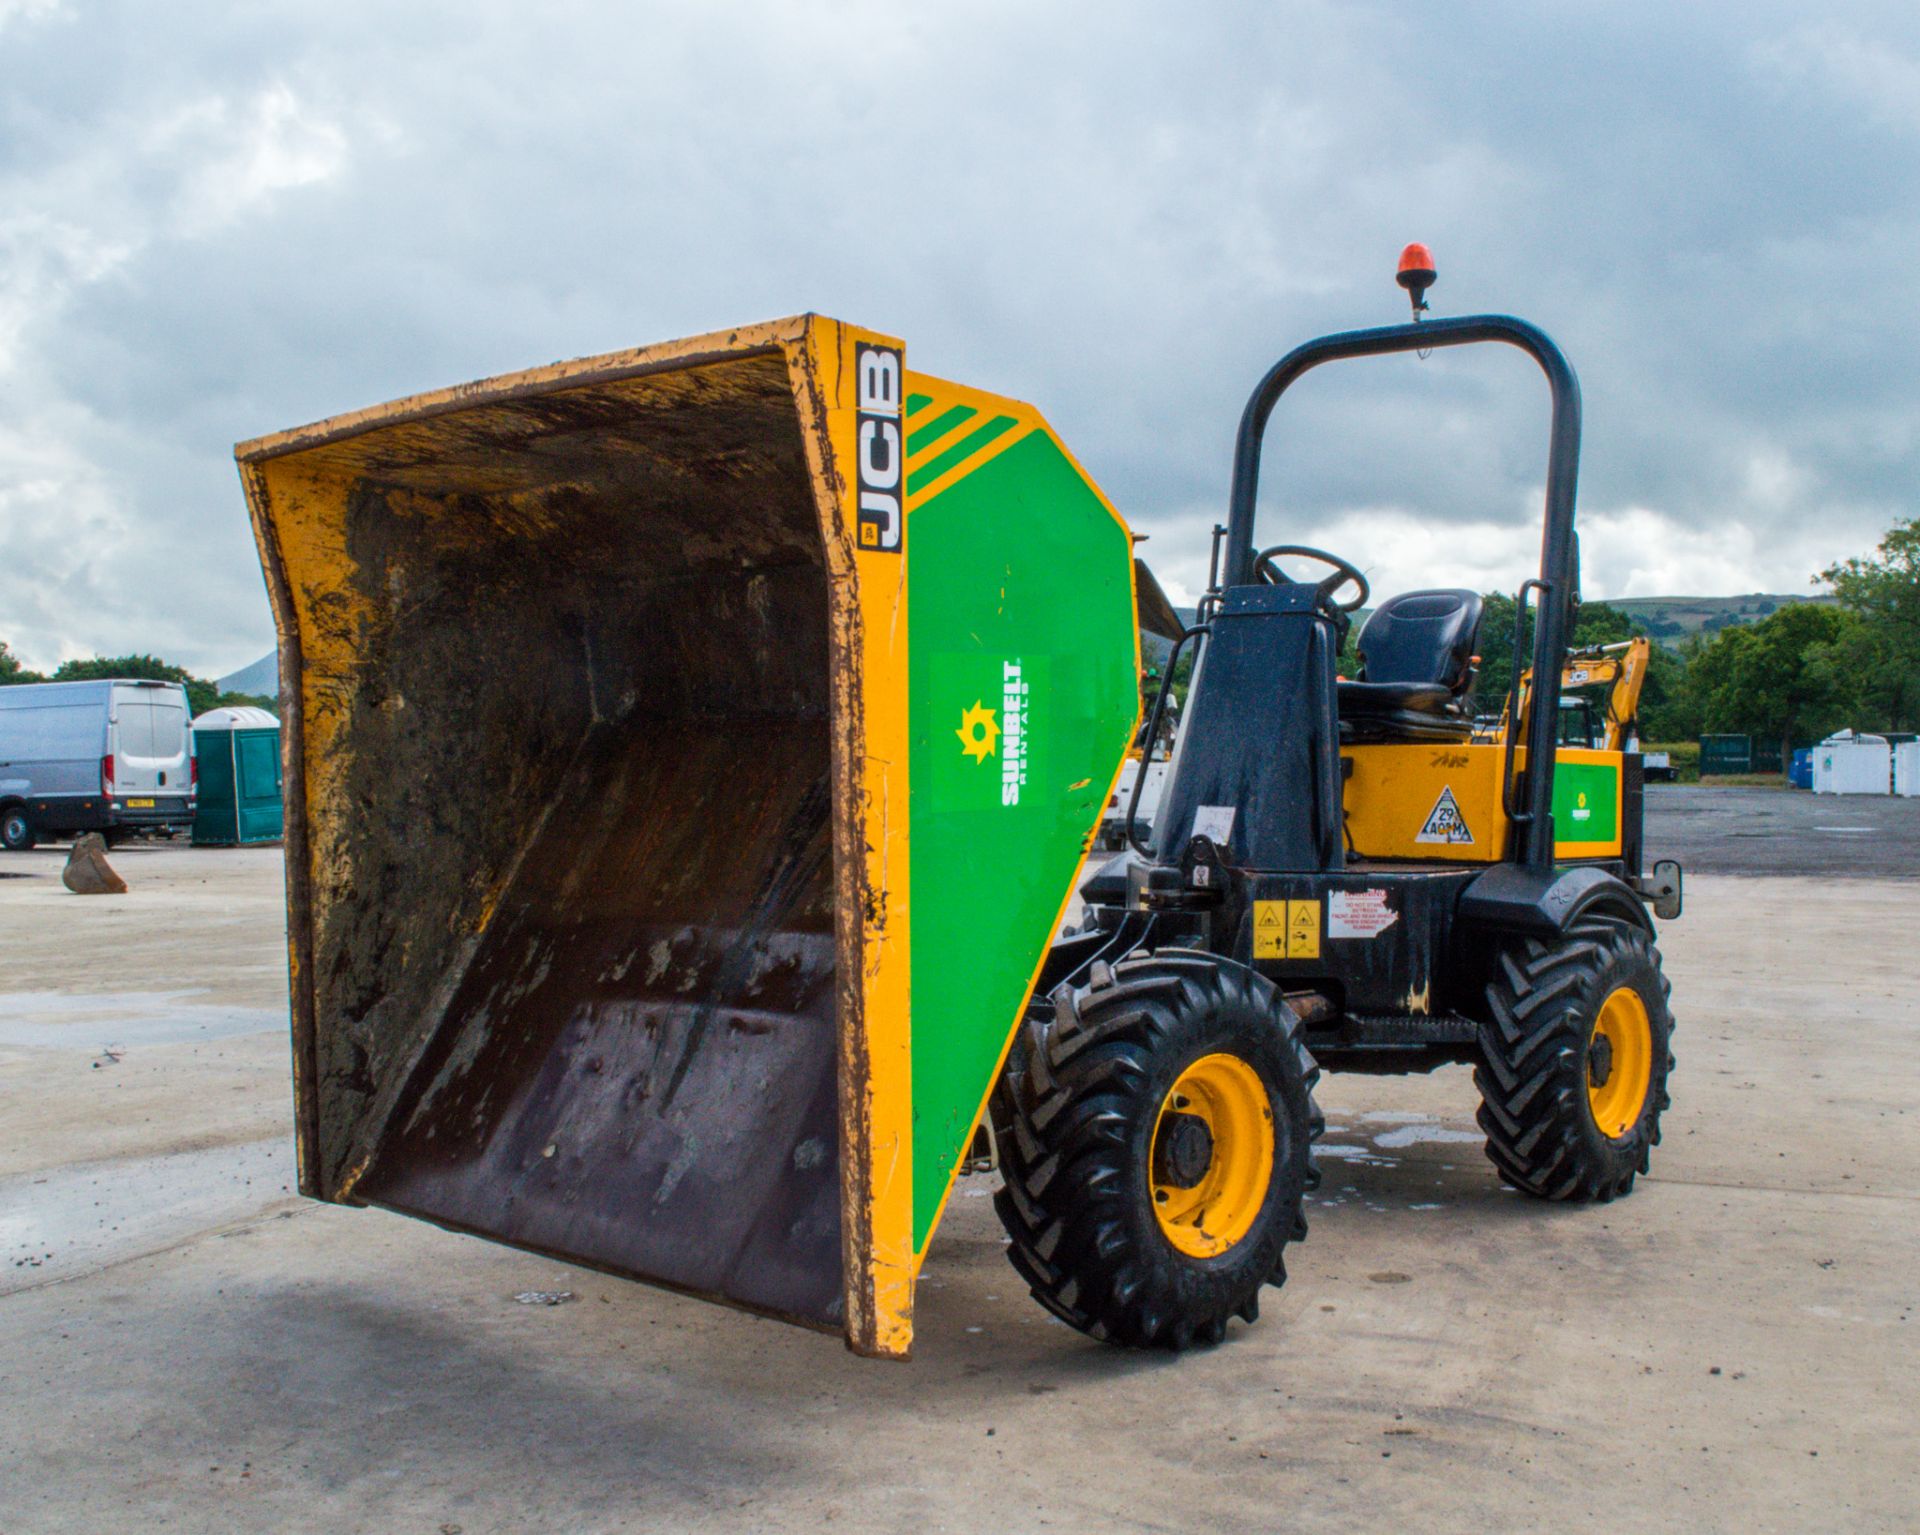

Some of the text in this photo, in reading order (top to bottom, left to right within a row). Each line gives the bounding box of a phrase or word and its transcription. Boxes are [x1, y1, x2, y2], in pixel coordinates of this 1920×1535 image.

[860, 349, 899, 548] JCB
[1568, 669, 1589, 683] JCB
[1002, 660, 1021, 807] SUNBELT
[1019, 682, 1029, 785] RENTALS
[1439, 808, 1454, 821] 29
